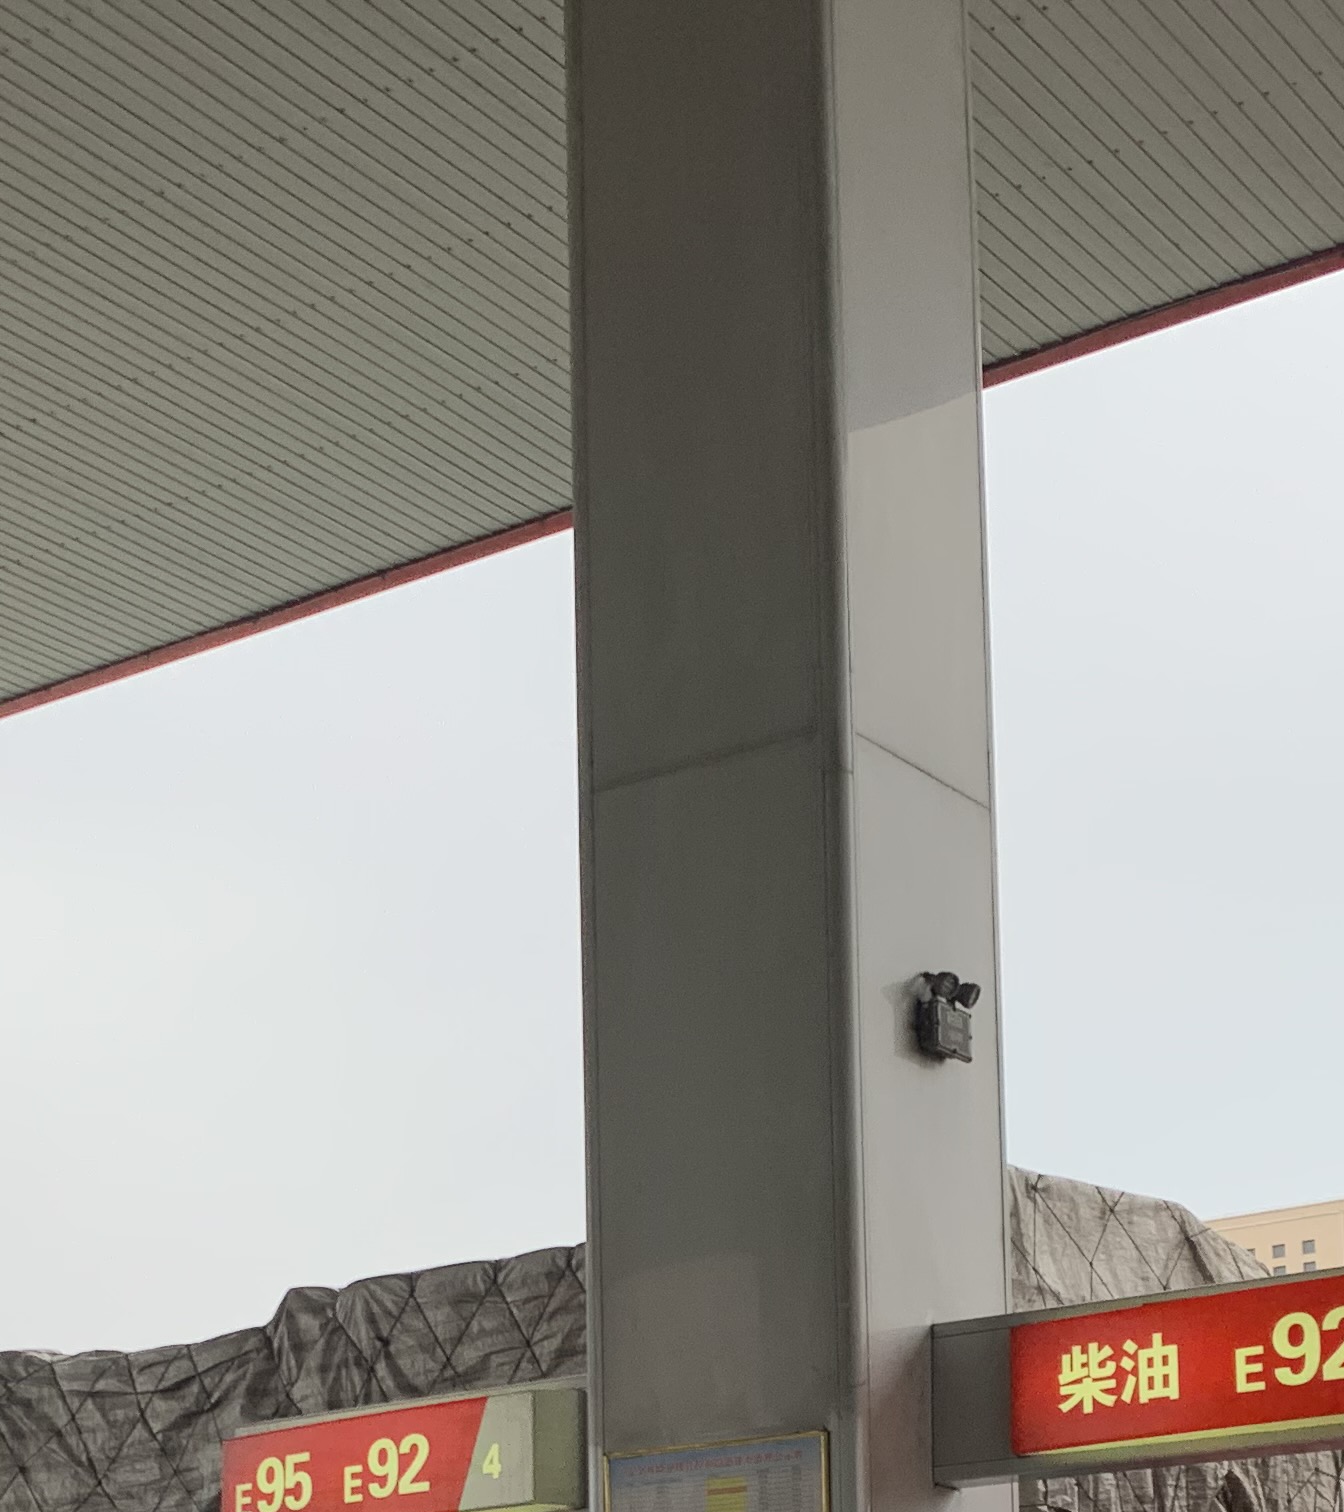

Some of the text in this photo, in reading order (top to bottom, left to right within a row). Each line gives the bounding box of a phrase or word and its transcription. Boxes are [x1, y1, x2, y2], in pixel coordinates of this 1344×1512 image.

[1057, 1331, 1180, 1415] 柴油
[343, 1433, 430, 1504] E92
[482, 1443, 502, 1480] 4
